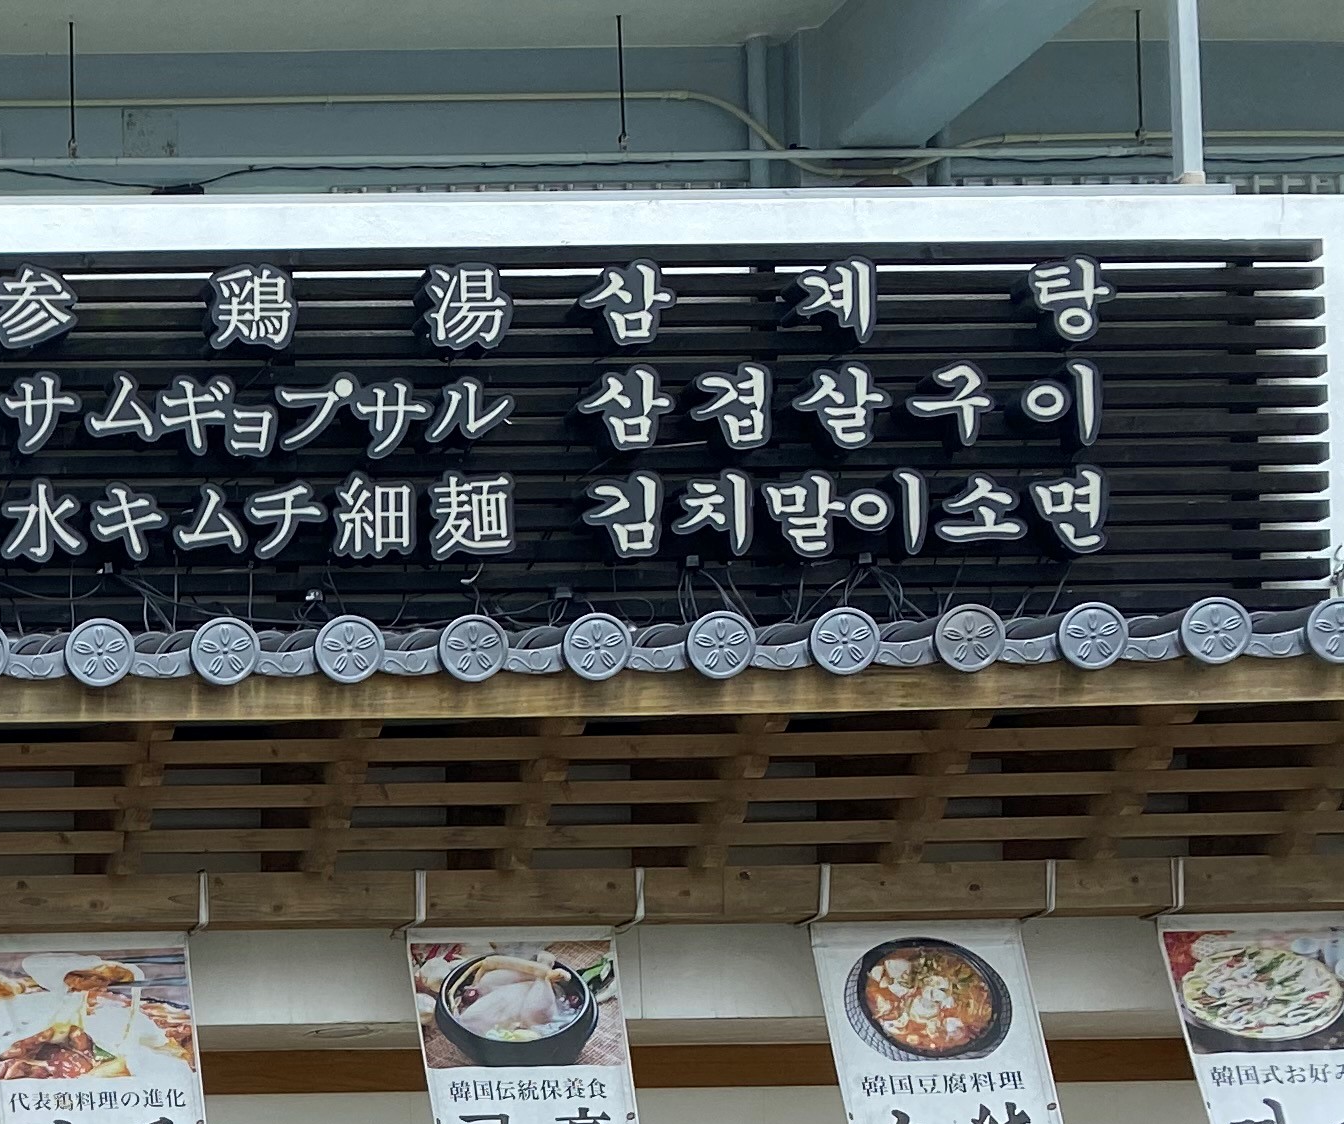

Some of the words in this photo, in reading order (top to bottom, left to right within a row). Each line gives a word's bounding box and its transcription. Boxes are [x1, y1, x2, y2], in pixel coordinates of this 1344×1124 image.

[583, 257, 1112, 343] 삼계탕
[2, 374, 511, 456] サムギョプサル
[579, 361, 1101, 447] 삼겹살구이
[2, 475, 513, 557] 水キムチ細麺
[586, 467, 1105, 554] 김치말이소면
[9, 1088, 187, 1112] 代表鶏料理の進化
[449, 1078, 608, 1102] 韓国伝統保養食
[861, 1070, 1026, 1097] 韓国豆腐料理
